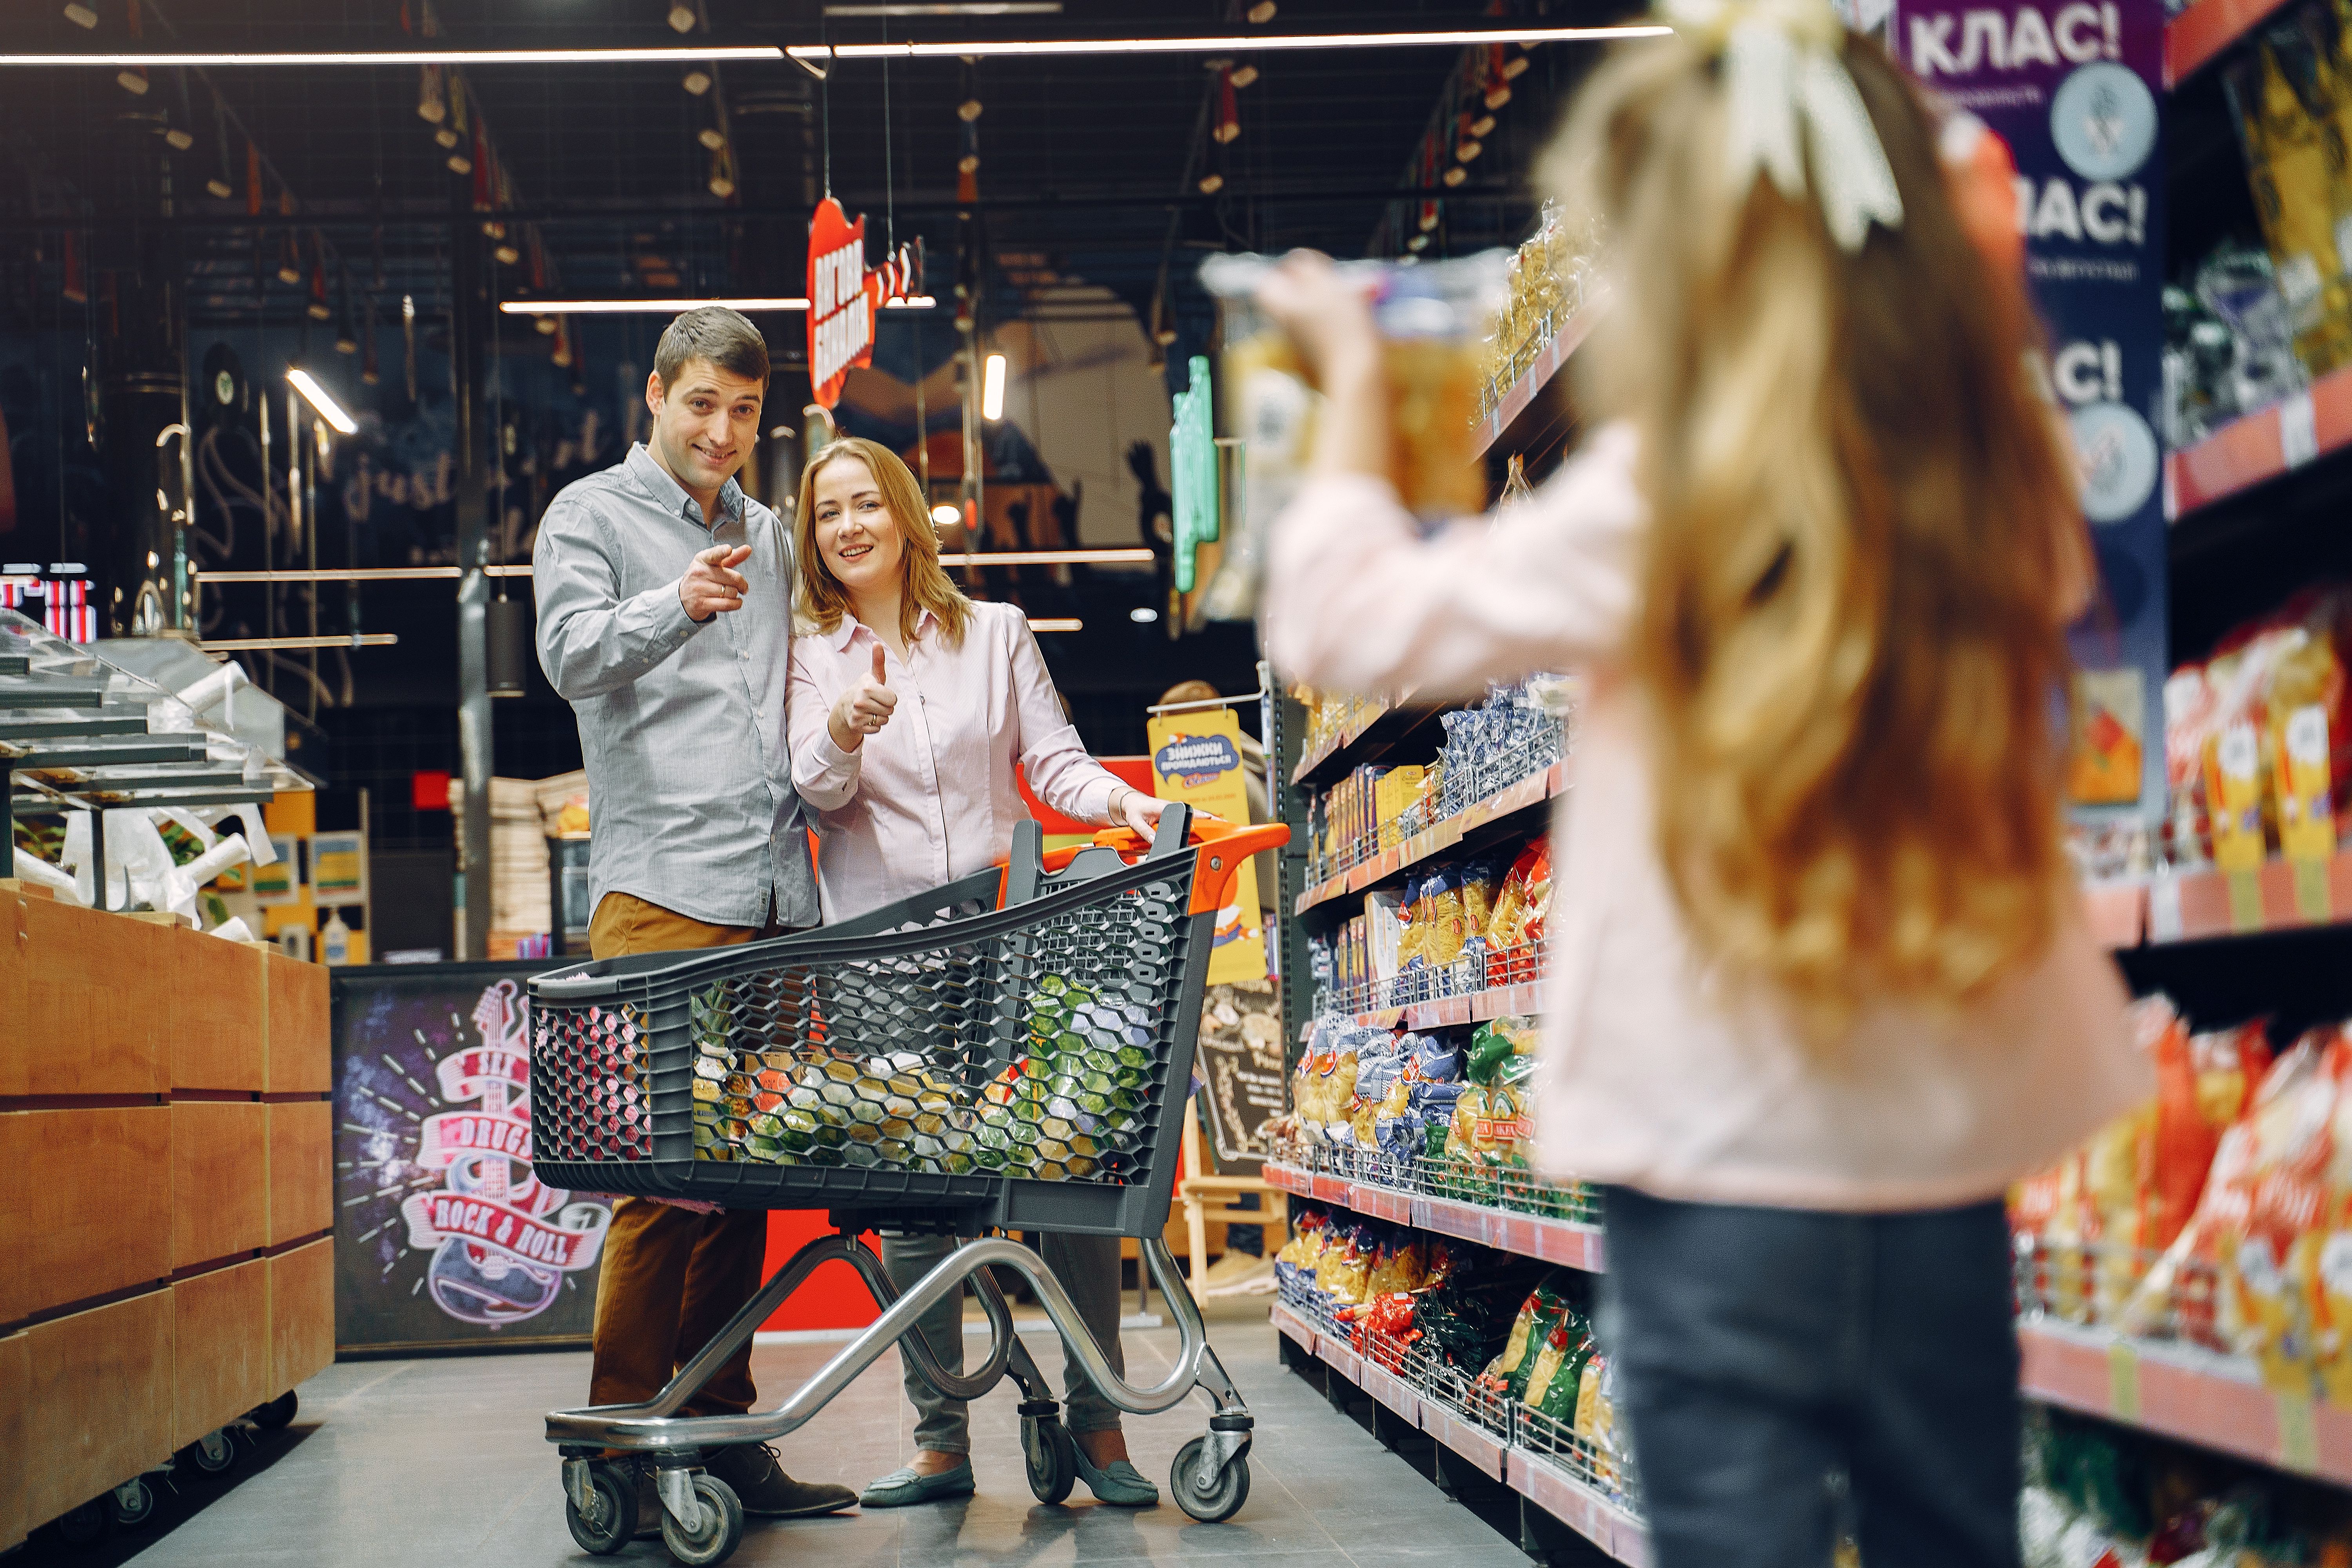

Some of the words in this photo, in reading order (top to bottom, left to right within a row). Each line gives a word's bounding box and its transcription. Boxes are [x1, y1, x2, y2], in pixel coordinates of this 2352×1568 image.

[1910, 0, 2121, 76] КЛАС!
[2011, 175, 2149, 248] АС!
[1167, 742, 1223, 762] ЗНИЖКИ
[461, 1118, 532, 1156] DRUGS
[434, 1198, 495, 1235] ROCK
[495, 1215, 513, 1244] &
[515, 1223, 567, 1264] ROLL
